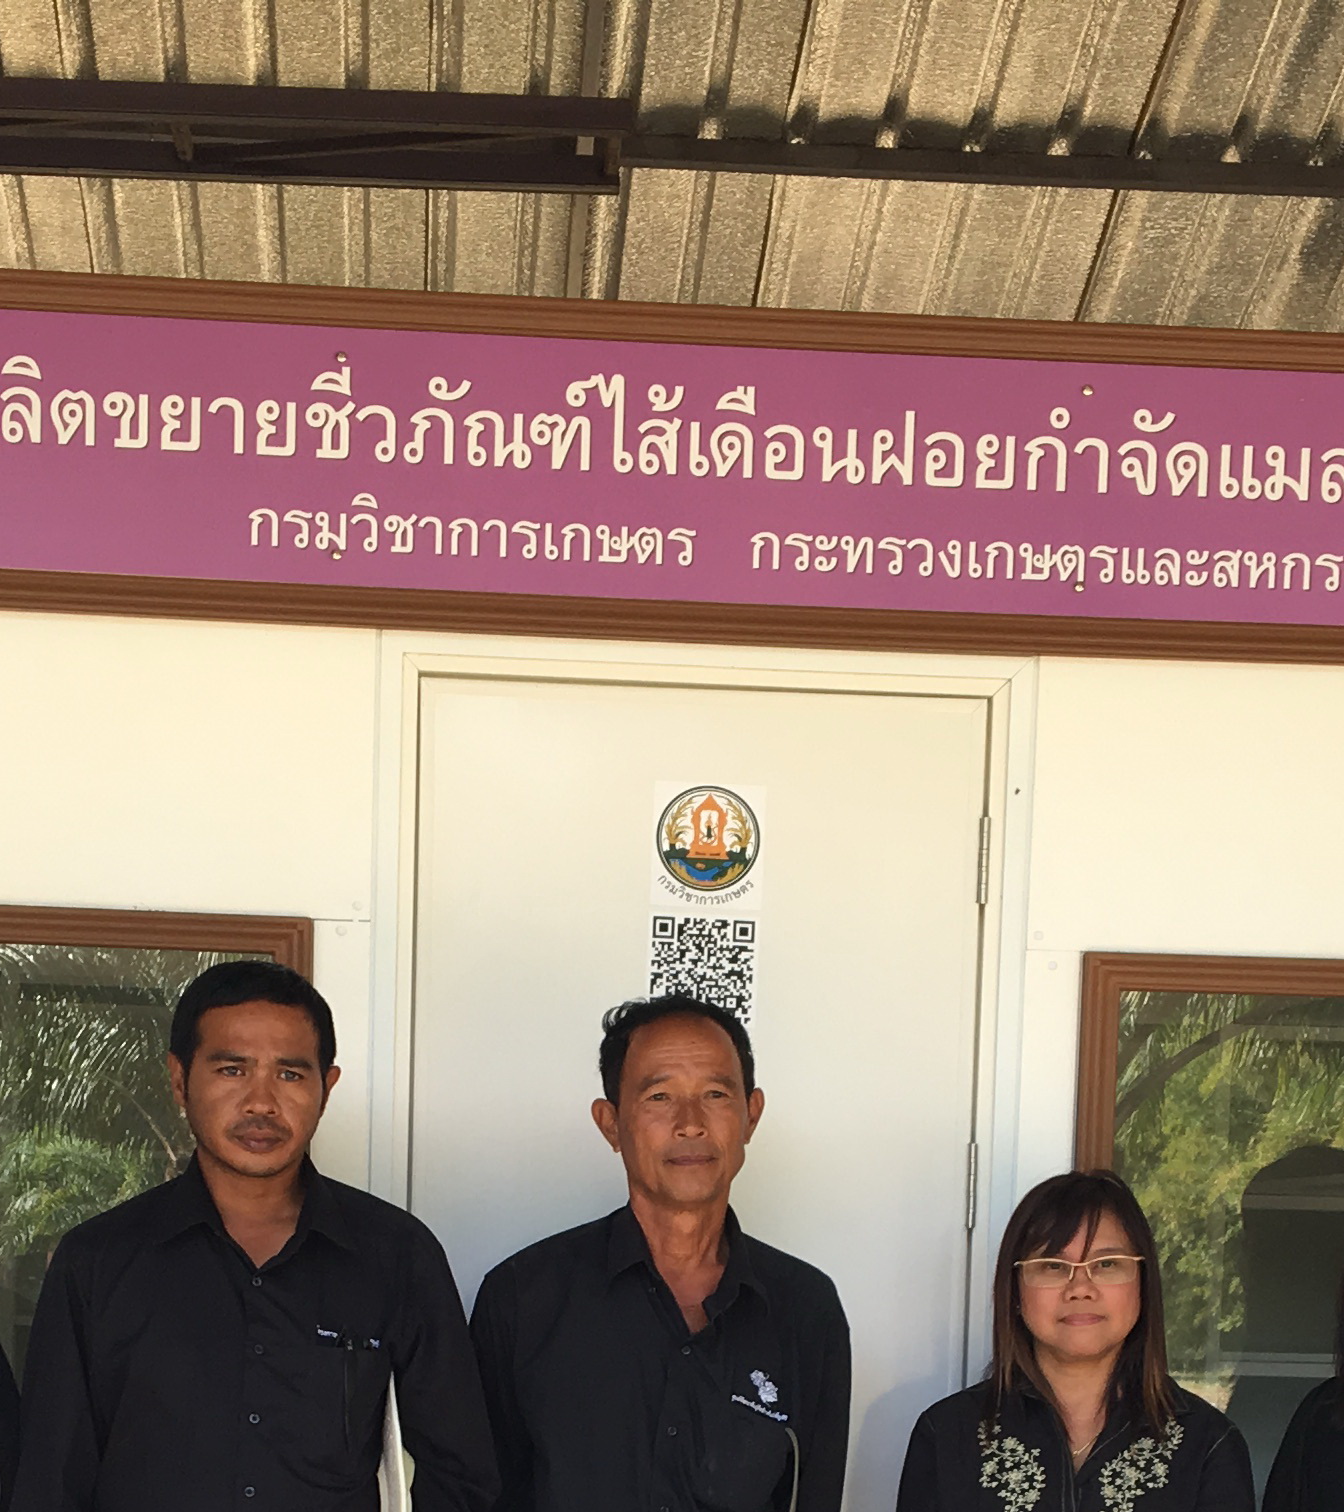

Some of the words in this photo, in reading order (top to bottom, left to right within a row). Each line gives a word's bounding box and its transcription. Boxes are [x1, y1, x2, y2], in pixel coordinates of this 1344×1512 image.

[248, 492, 697, 570] กรมวิชาการเกษตร
[657, 875, 755, 905] กรมวิชาการเกษตร
